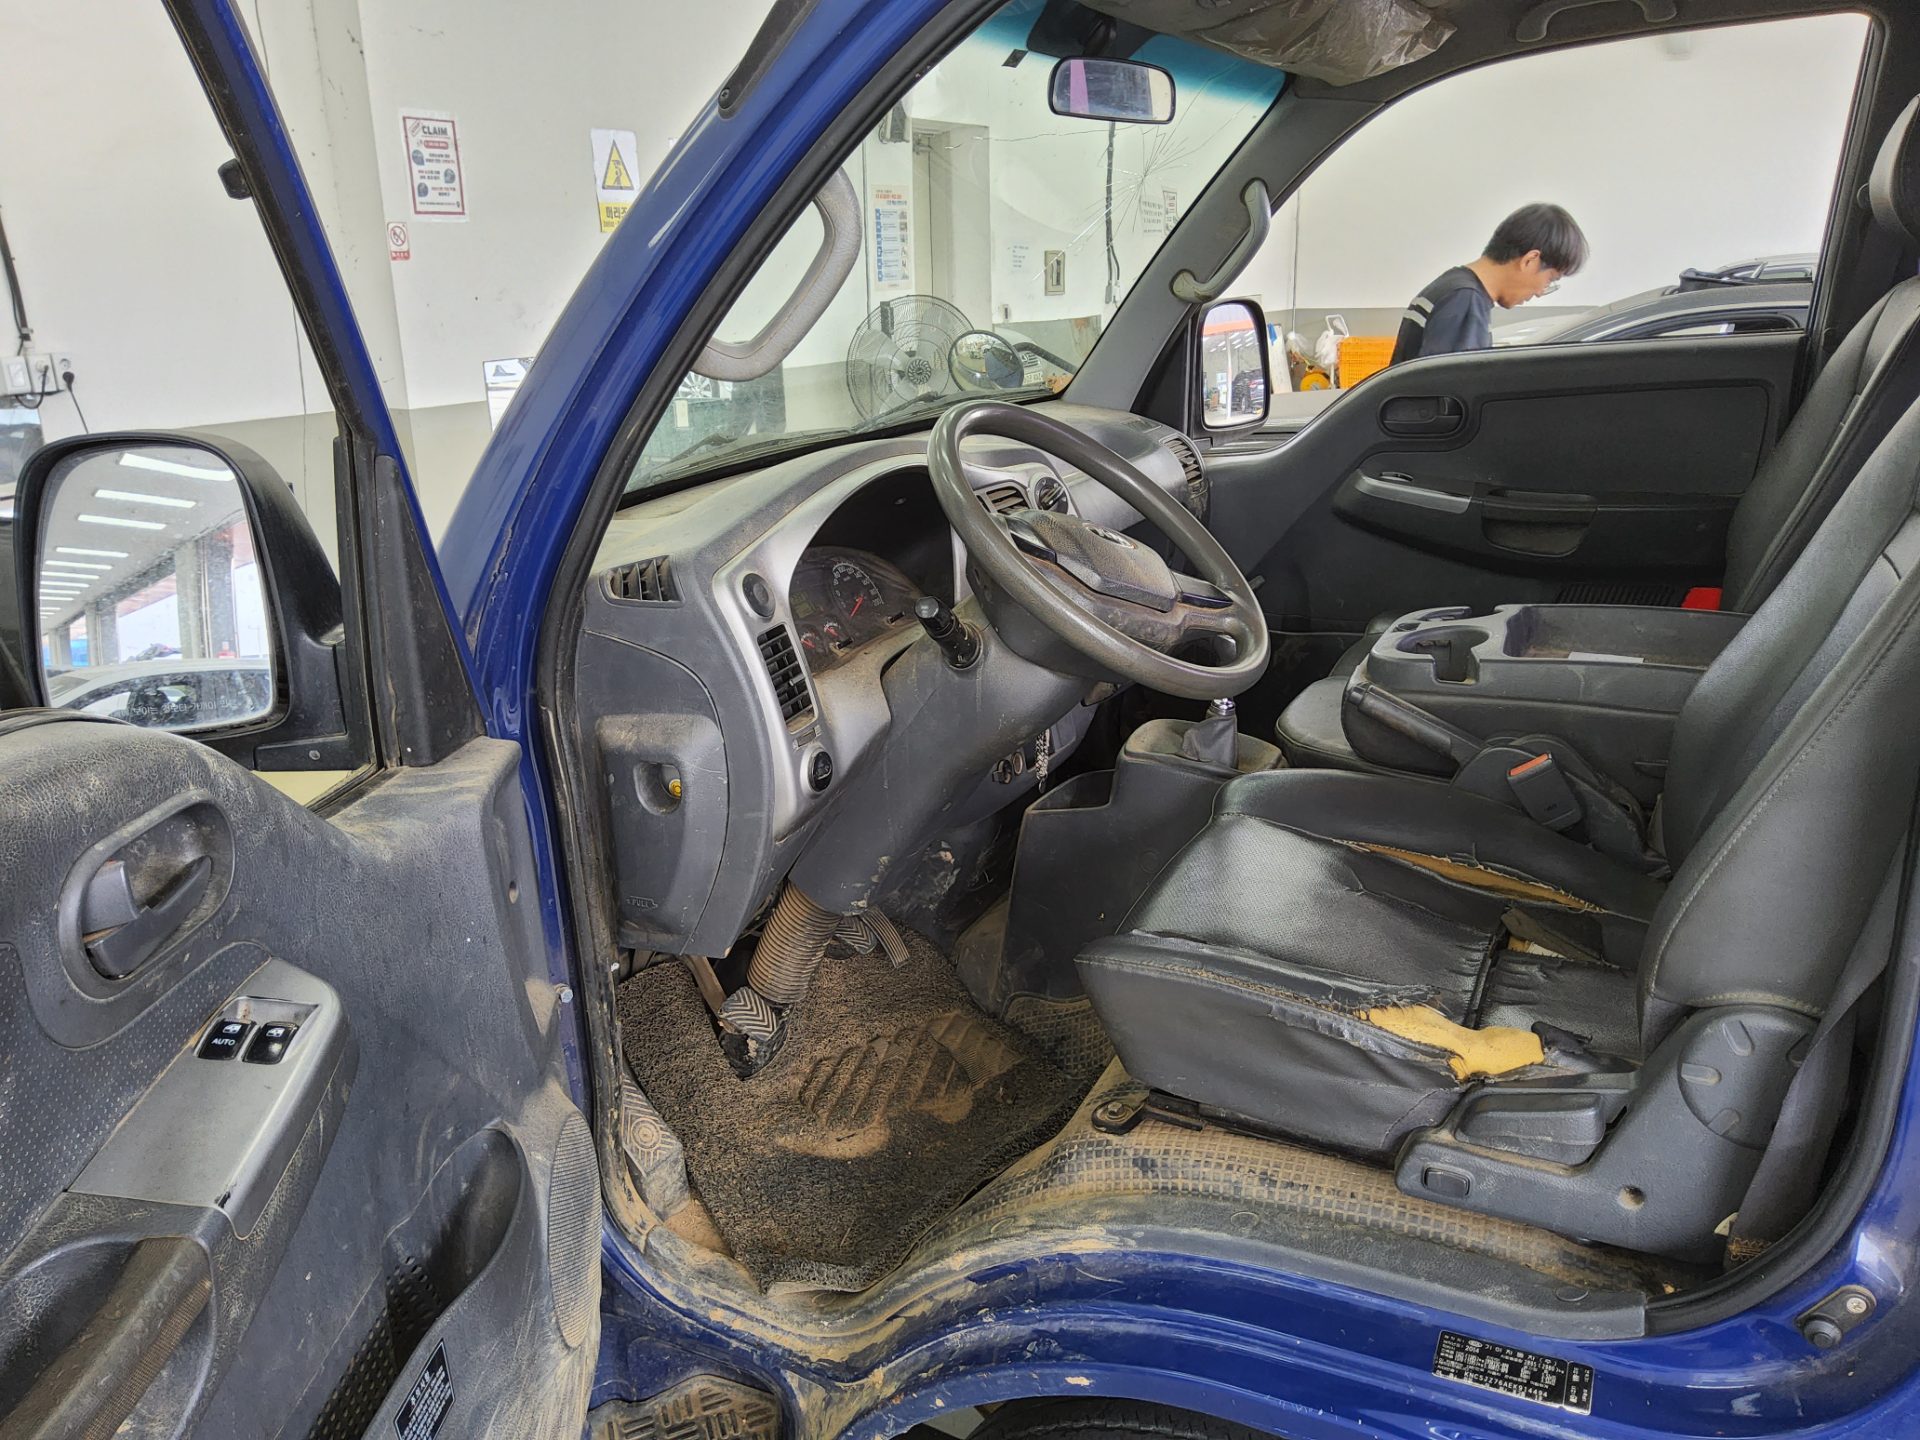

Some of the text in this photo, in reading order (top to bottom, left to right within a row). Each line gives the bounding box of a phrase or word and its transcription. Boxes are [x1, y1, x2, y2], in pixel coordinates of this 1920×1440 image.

[421, 125, 448, 136] CLAIM
[211, 1038, 235, 1046] AUTO
[1465, 1345, 1480, 1354] 2014
